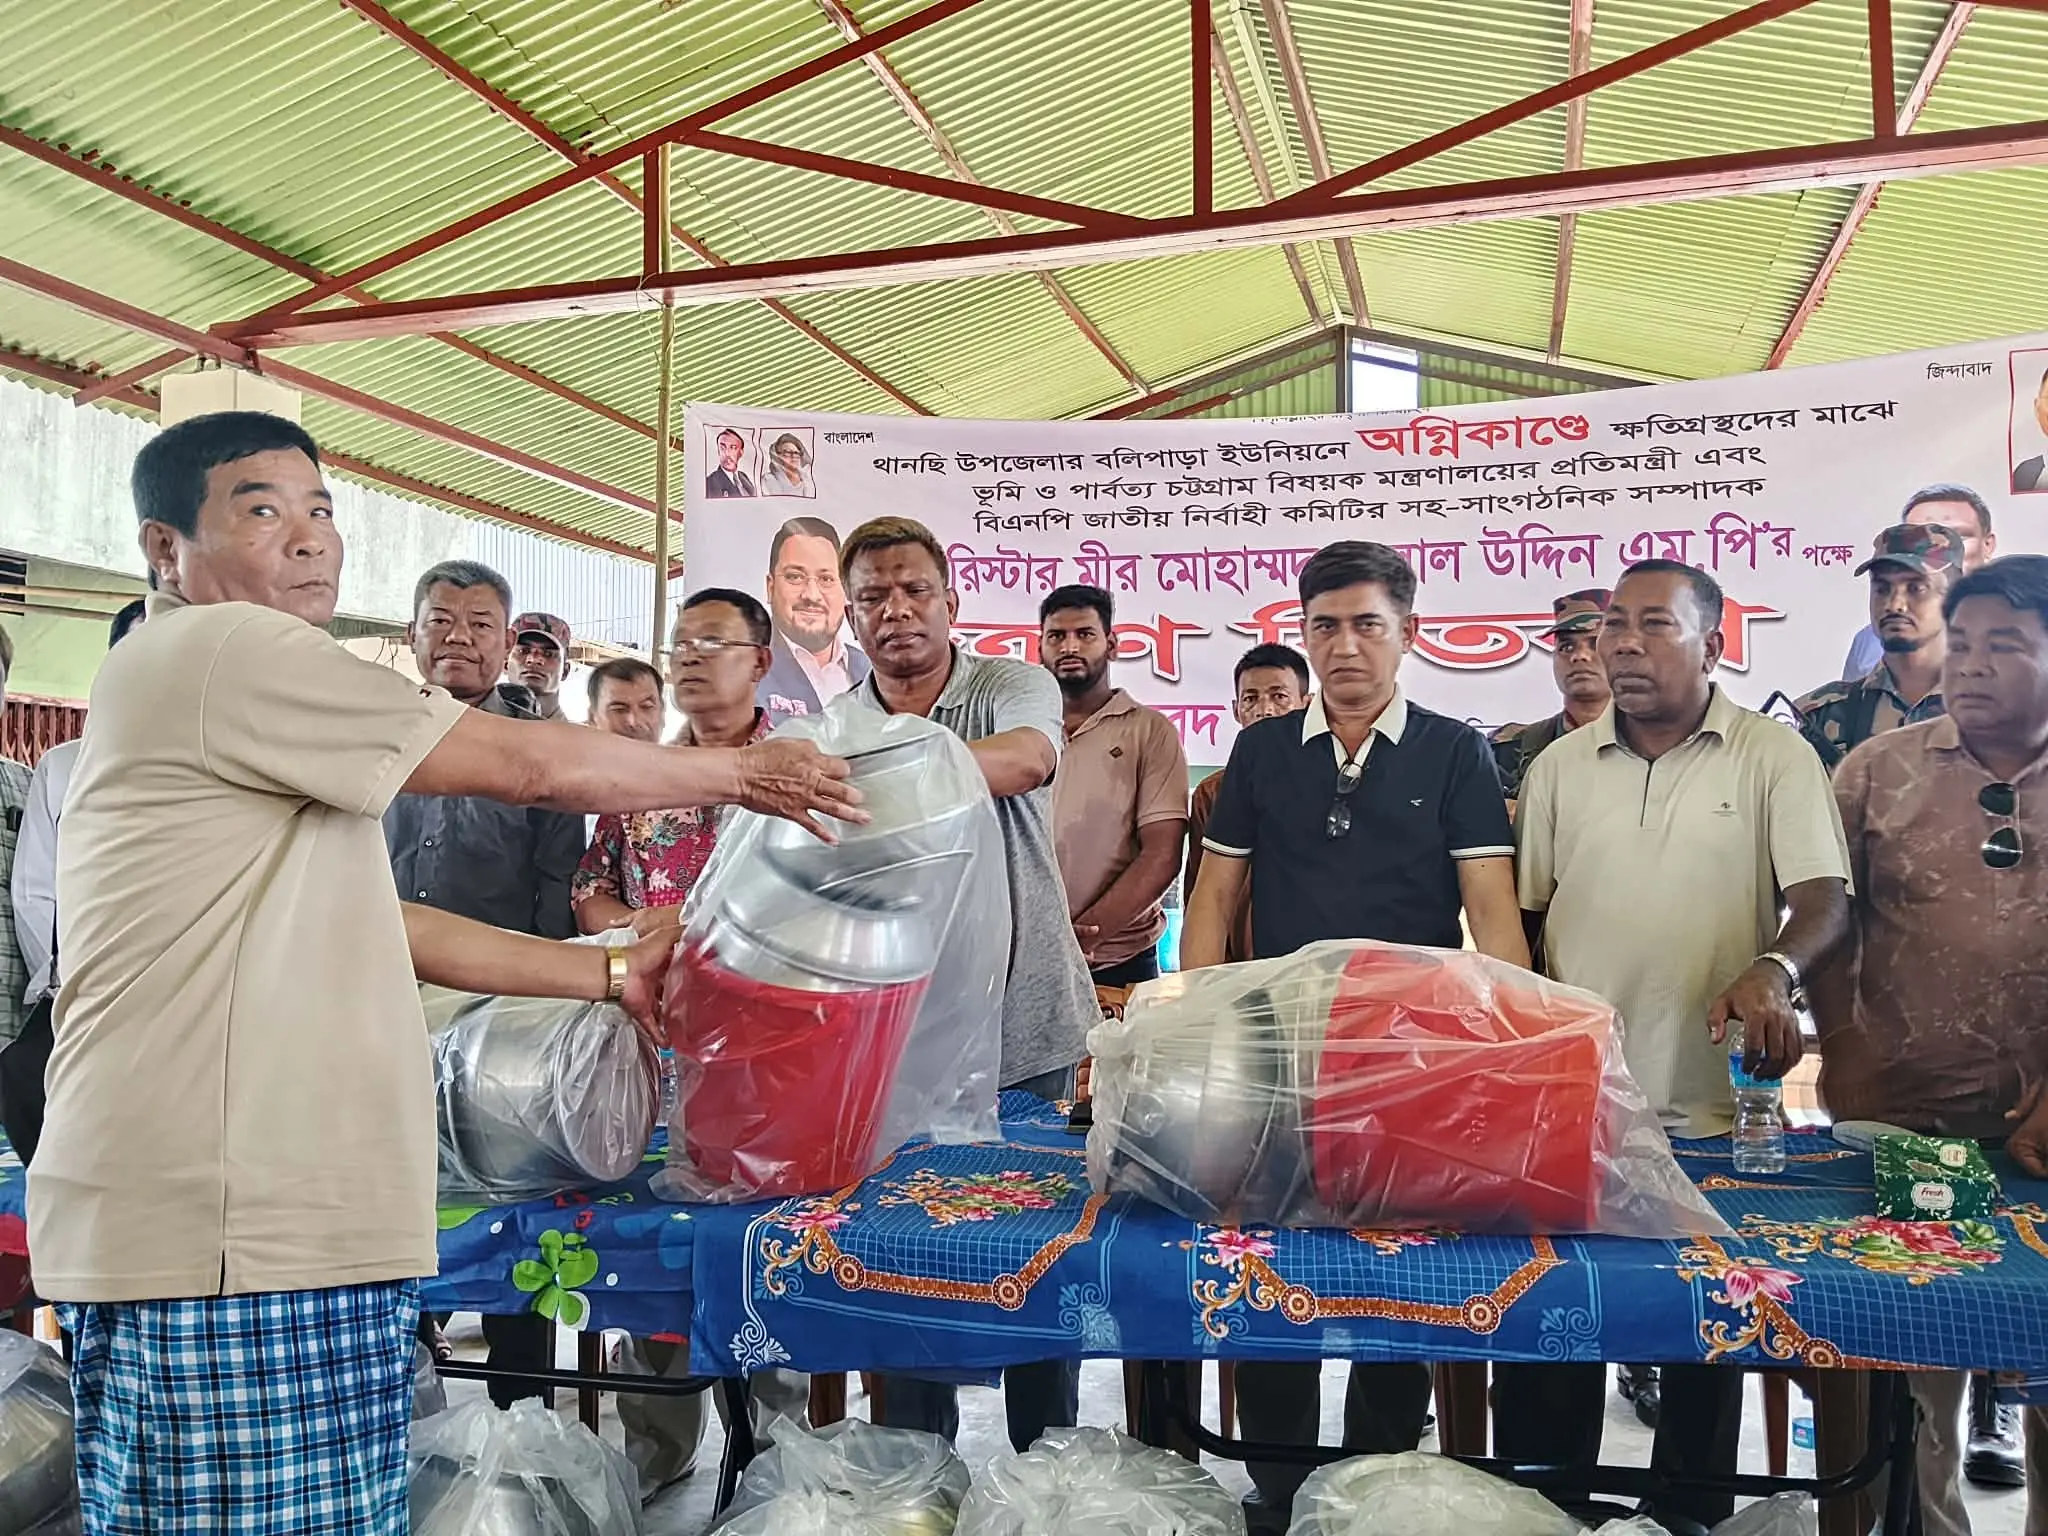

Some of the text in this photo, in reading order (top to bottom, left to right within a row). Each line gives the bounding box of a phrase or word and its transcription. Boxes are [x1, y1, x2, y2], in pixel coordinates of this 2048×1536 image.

[1926, 362, 1993, 379] জিন্দাবাদ
[824, 431, 875, 445] বাংলাদেশ
[872, 452, 948, 476] থানছি
[955, 451, 1083, 473] উপজেলার
[1092, 447, 1208, 470] বলিপাড়া
[1216, 440, 1350, 467] ইউনিয়নে
[1354, 414, 1591, 459] অগ্নিকাণ্ডে
[1809, 400, 1898, 426] মাঝে
[972, 447, 1767, 508] ভূমি ও পার্বত্য চট্টগ্রাম বিষয়ক মন্ত্রণালয়ের প্রতিমন্ত্রী এবং
[972, 477, 1767, 533] বিএনপি জাতীয় নির্বাহী কমিটির সহ-সাংগঠনিক সম্পাদক
[1072, 539, 1143, 592] মীর
[1477, 522, 1604, 579] উদ্দিন
[1802, 544, 1854, 567] পক্ষে
[1921, 1186, 1944, 1197] Fresh
